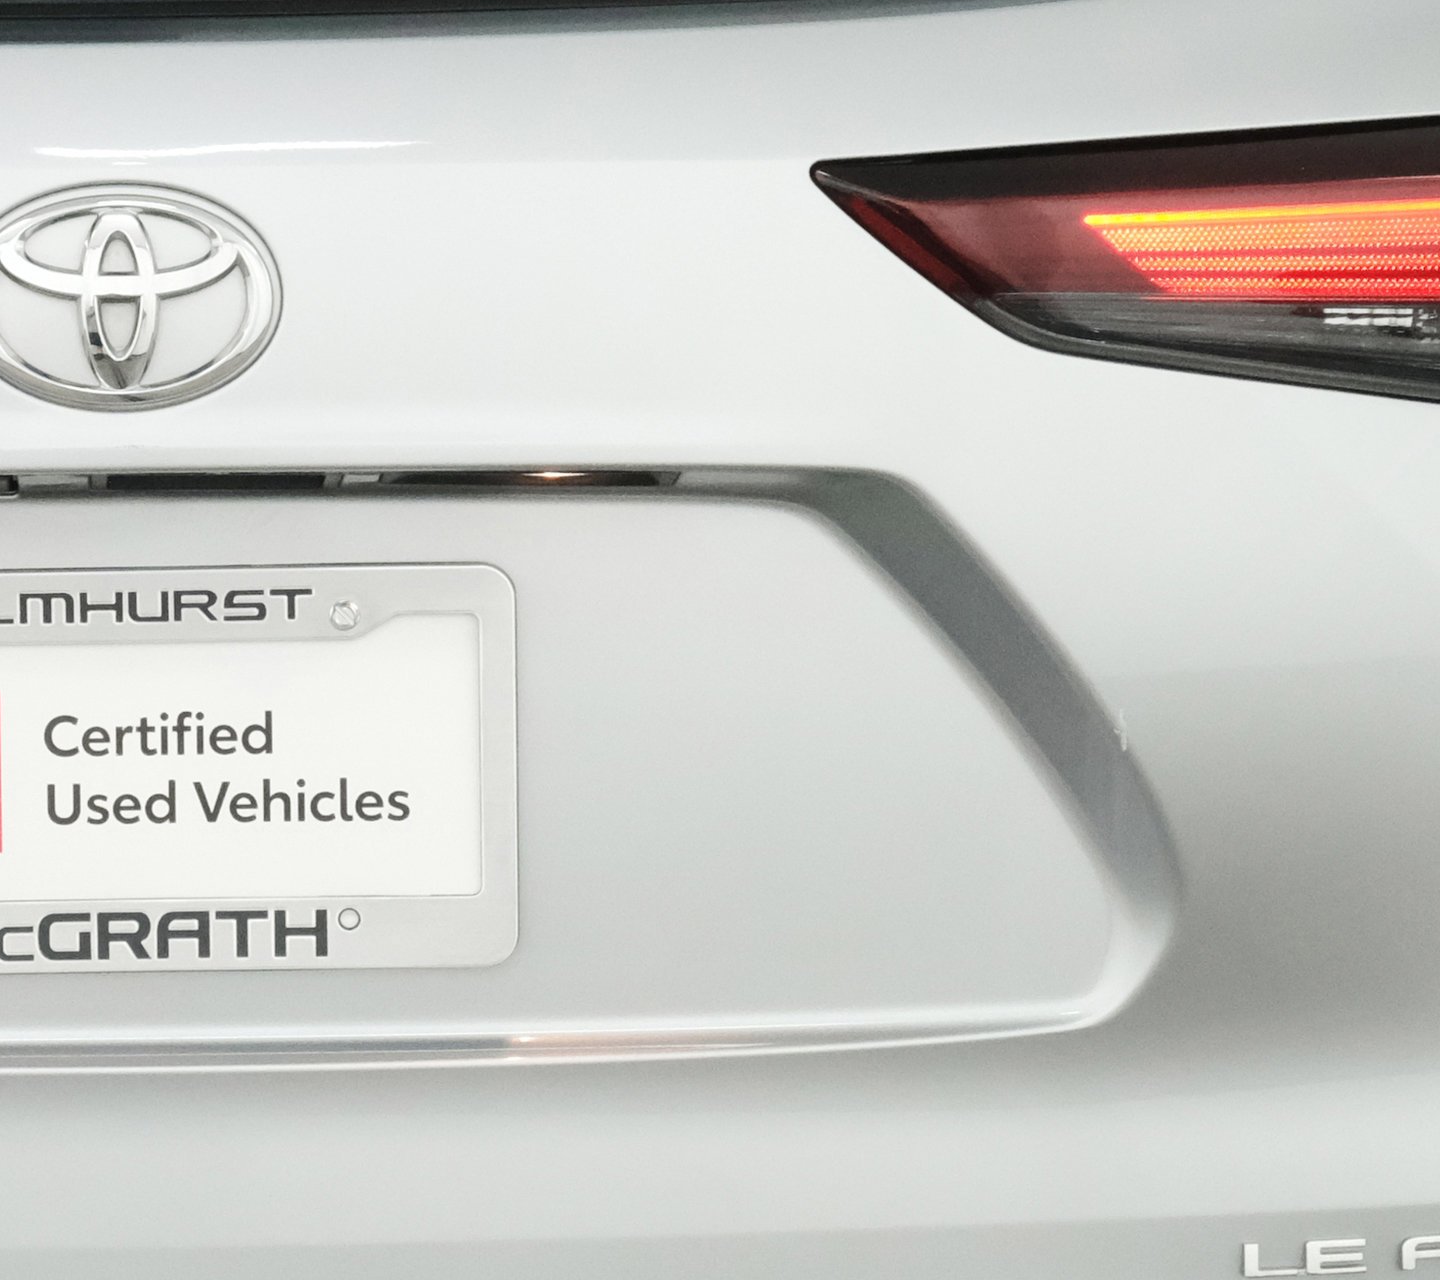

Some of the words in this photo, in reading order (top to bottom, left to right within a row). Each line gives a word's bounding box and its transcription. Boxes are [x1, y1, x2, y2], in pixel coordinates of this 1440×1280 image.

[44, 712, 274, 757] Certified
[46, 782, 177, 826] Used
[193, 778, 411, 822] Vehicles
[1243, 1238, 1366, 1276] LE
